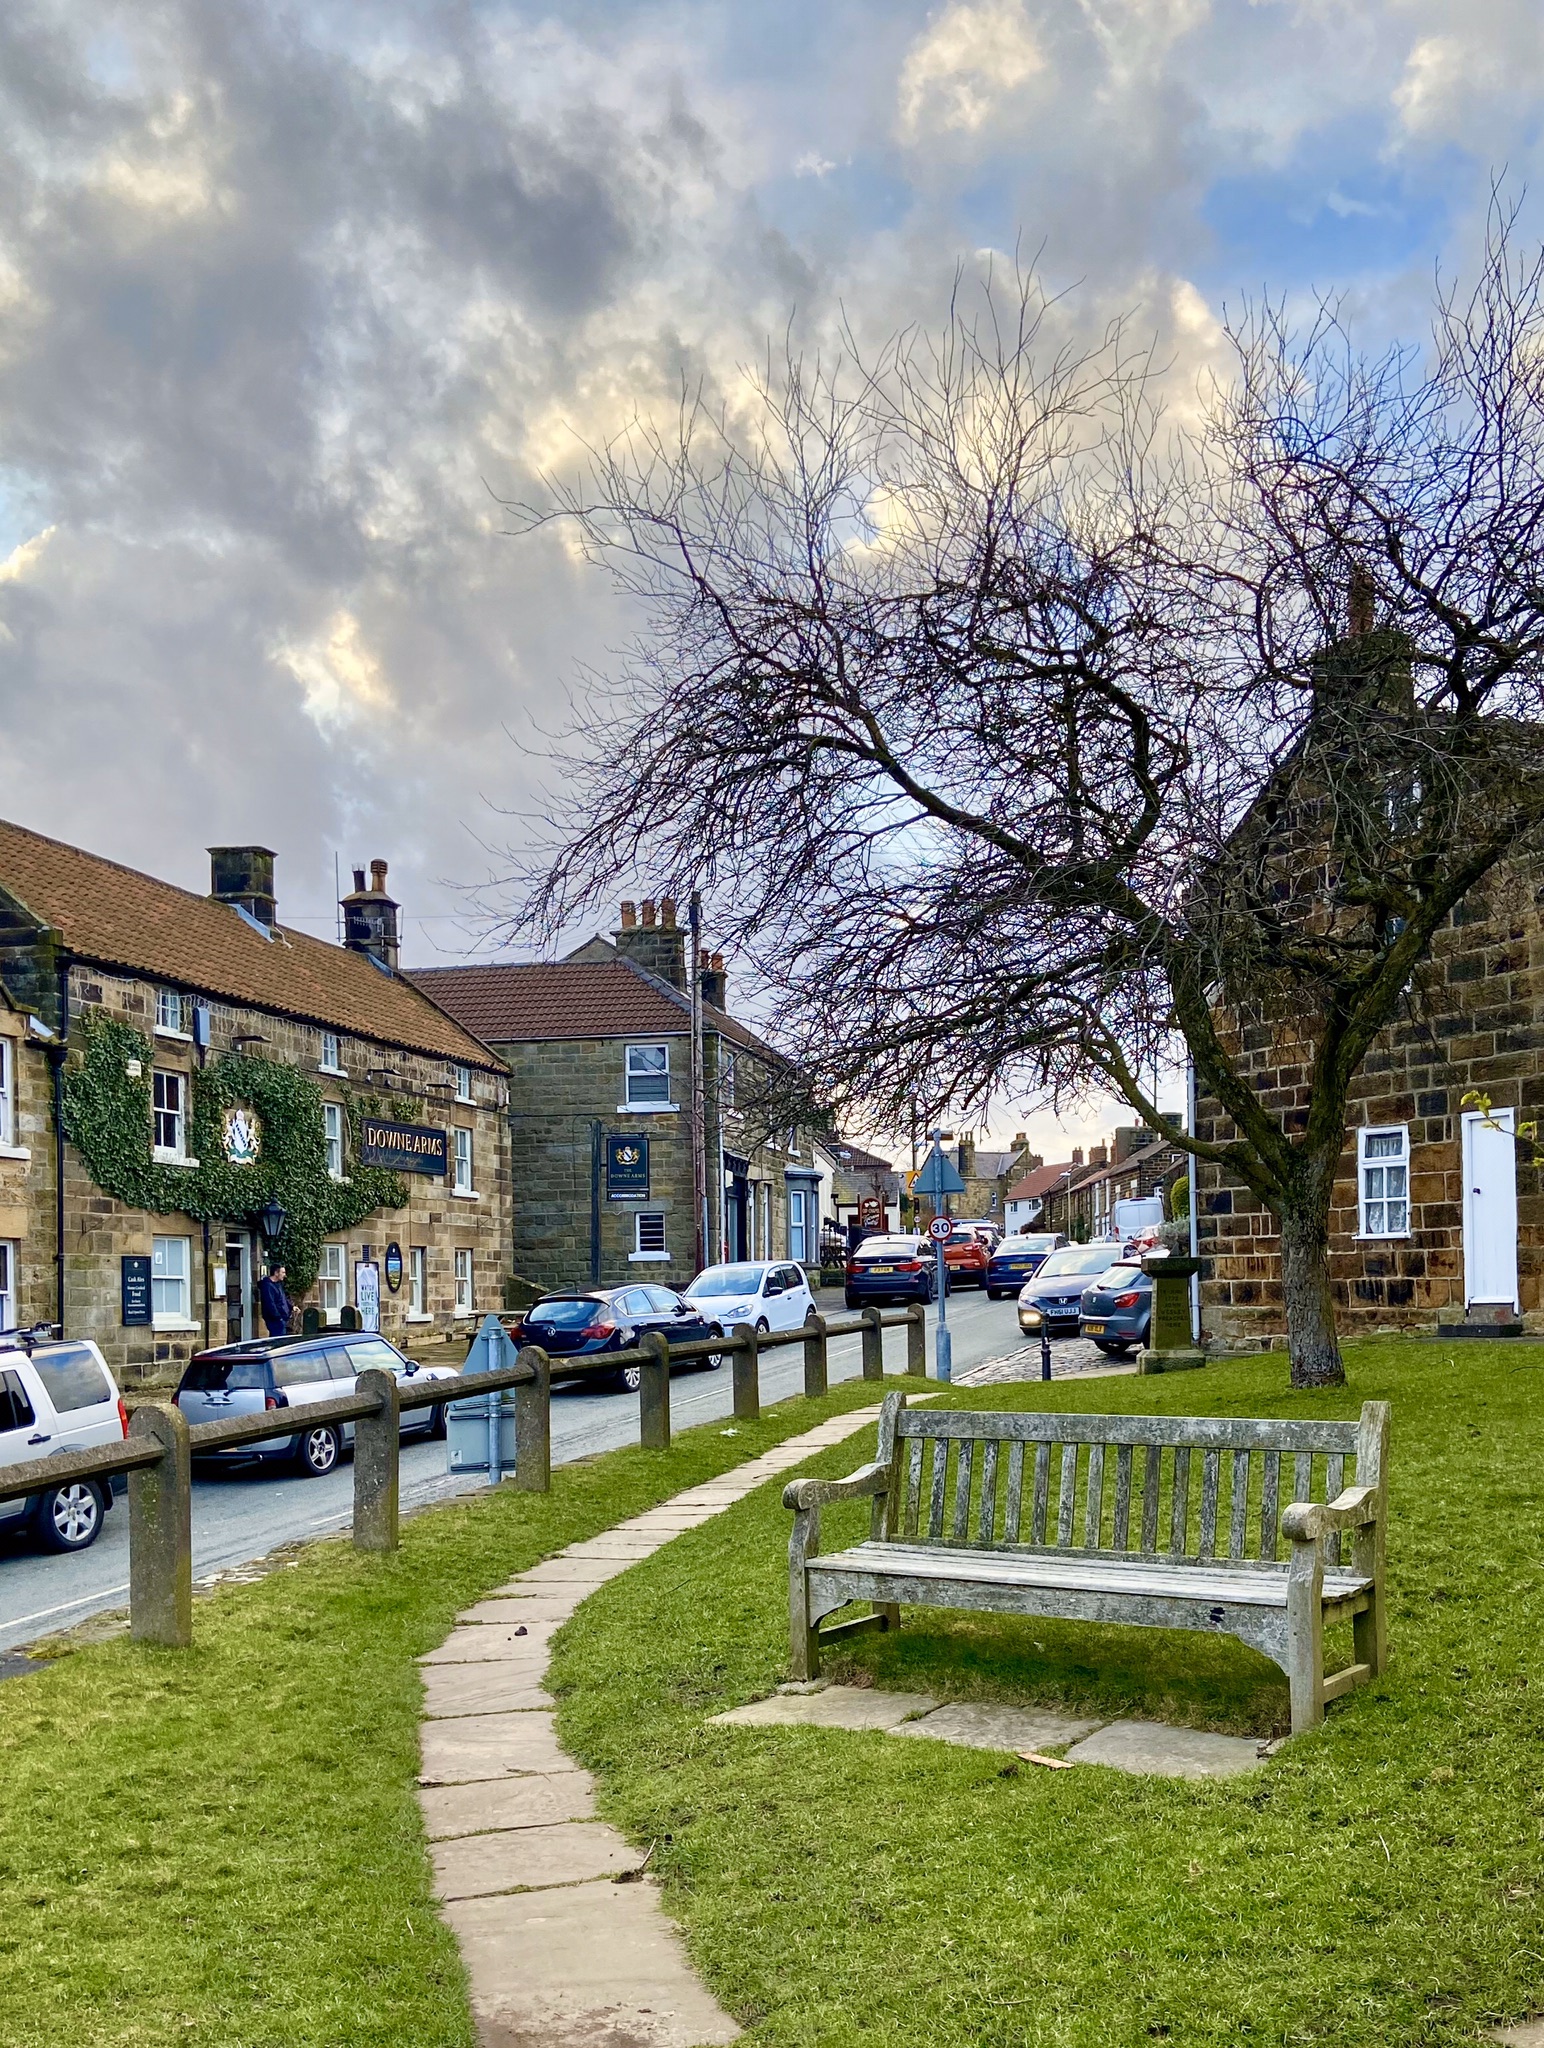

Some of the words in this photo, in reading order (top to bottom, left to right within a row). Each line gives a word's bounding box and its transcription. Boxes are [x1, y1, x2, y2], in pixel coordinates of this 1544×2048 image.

[367, 1127, 412, 1152] DOWNE
[413, 1135, 443, 1156] ARMS
[932, 1222, 950, 1234] 30
[360, 1291, 374, 1302] LIVE
[361, 1307, 375, 1315] HERE
